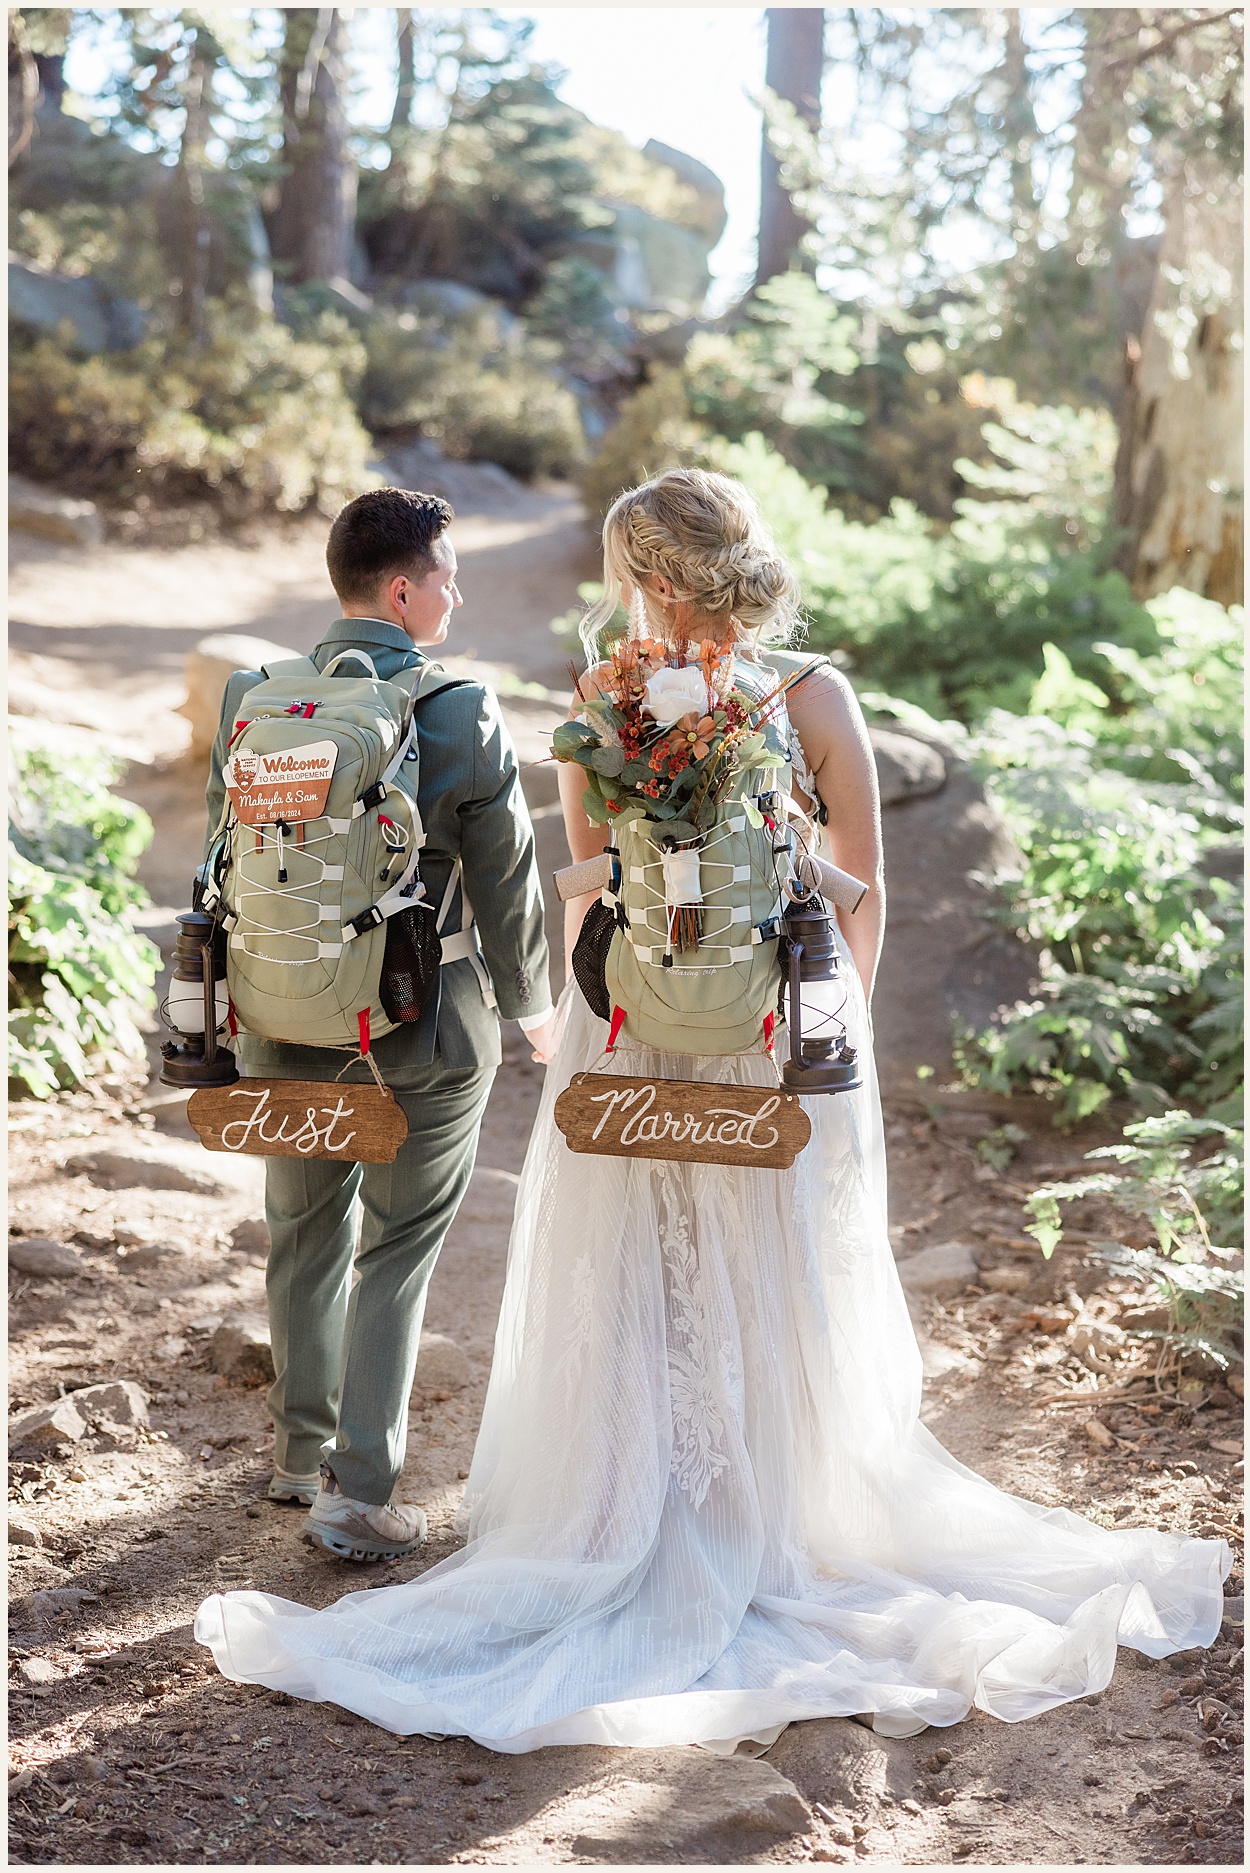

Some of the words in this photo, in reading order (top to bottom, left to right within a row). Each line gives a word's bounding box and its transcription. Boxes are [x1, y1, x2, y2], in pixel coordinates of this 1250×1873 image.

[263, 756, 330, 773] Welcome
[287, 771, 329, 780] ELOPEMENT
[239, 791, 283, 810] Makayla
[285, 791, 293, 803] &
[295, 790, 319, 803] Sam
[269, 810, 301, 819] 08/16/2024
[222, 1089, 356, 1153] Just
[591, 1085, 781, 1149] Married
